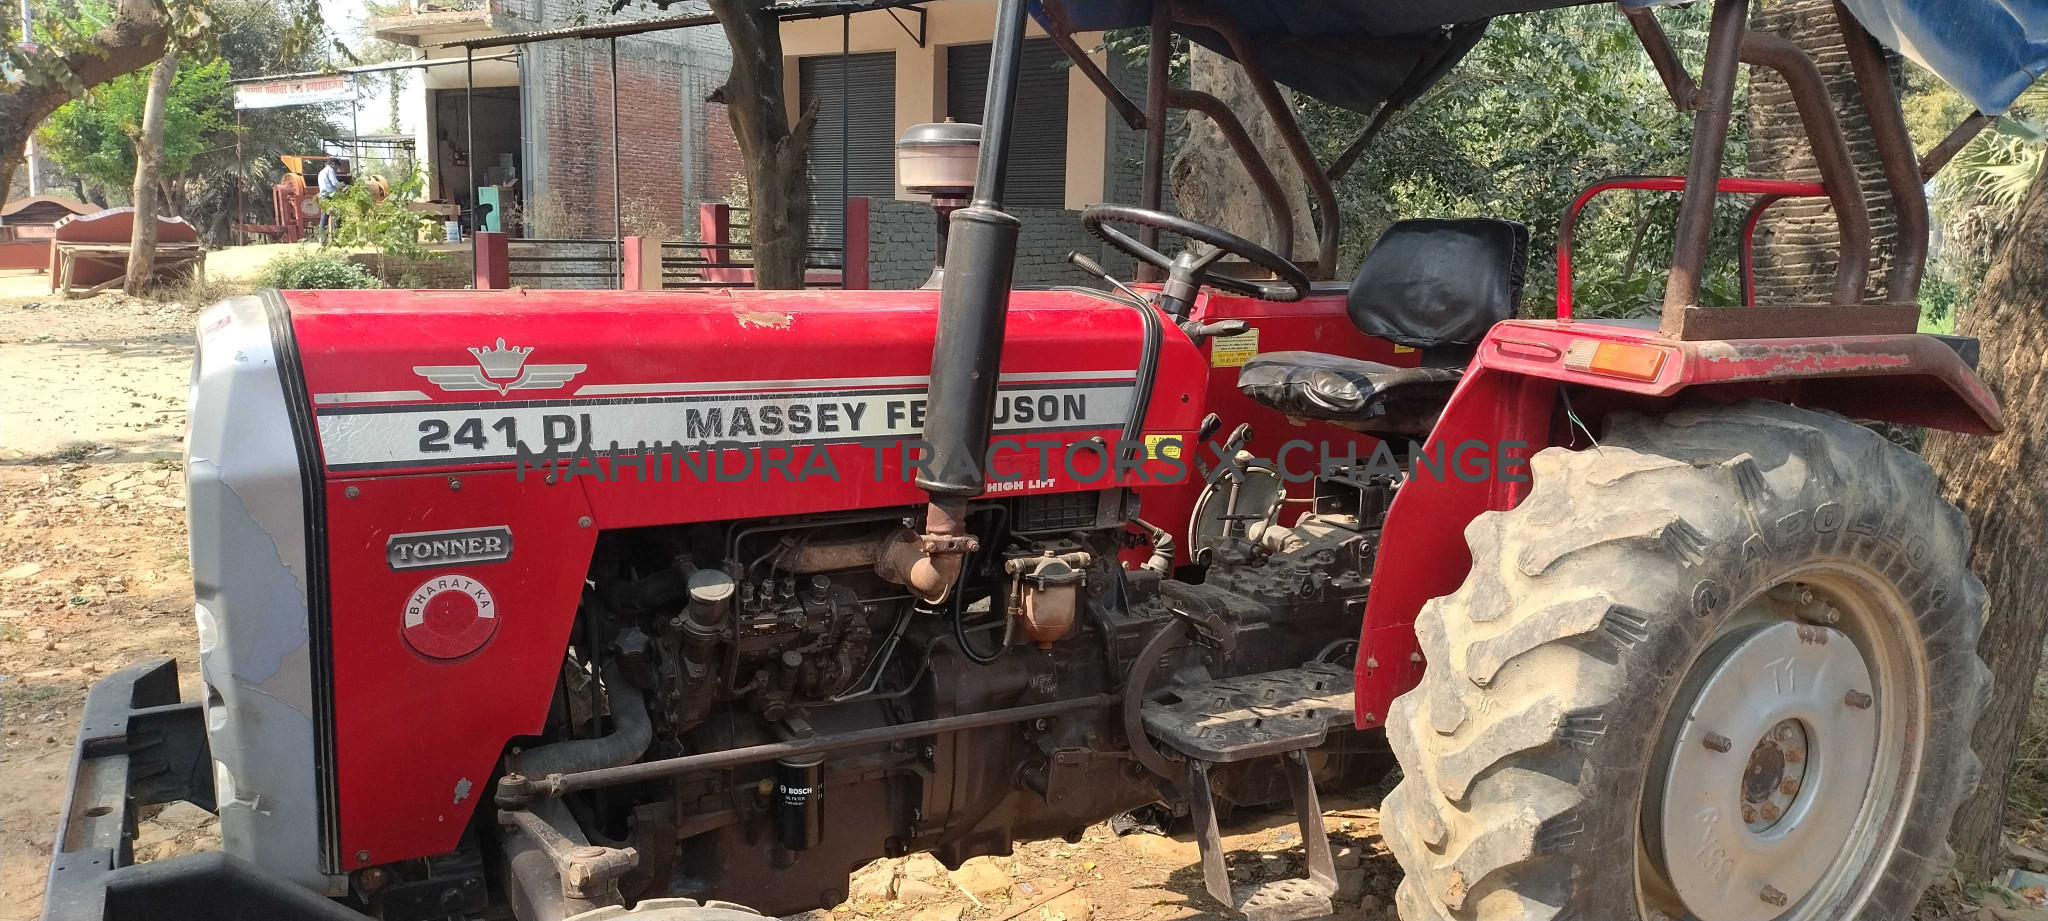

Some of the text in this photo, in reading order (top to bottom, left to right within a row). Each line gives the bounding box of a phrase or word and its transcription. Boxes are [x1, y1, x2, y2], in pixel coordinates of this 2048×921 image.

[418, 413, 592, 453] 241 DI
[685, 394, 1086, 439] MASSEY FEUSON
[987, 478, 1056, 492] HIGH LIFT
[394, 536, 502, 560] TONNER
[1738, 501, 1932, 580] APOLLO
[409, 579, 491, 615] BHARAT KA
[788, 787, 813, 795] BOSCH
